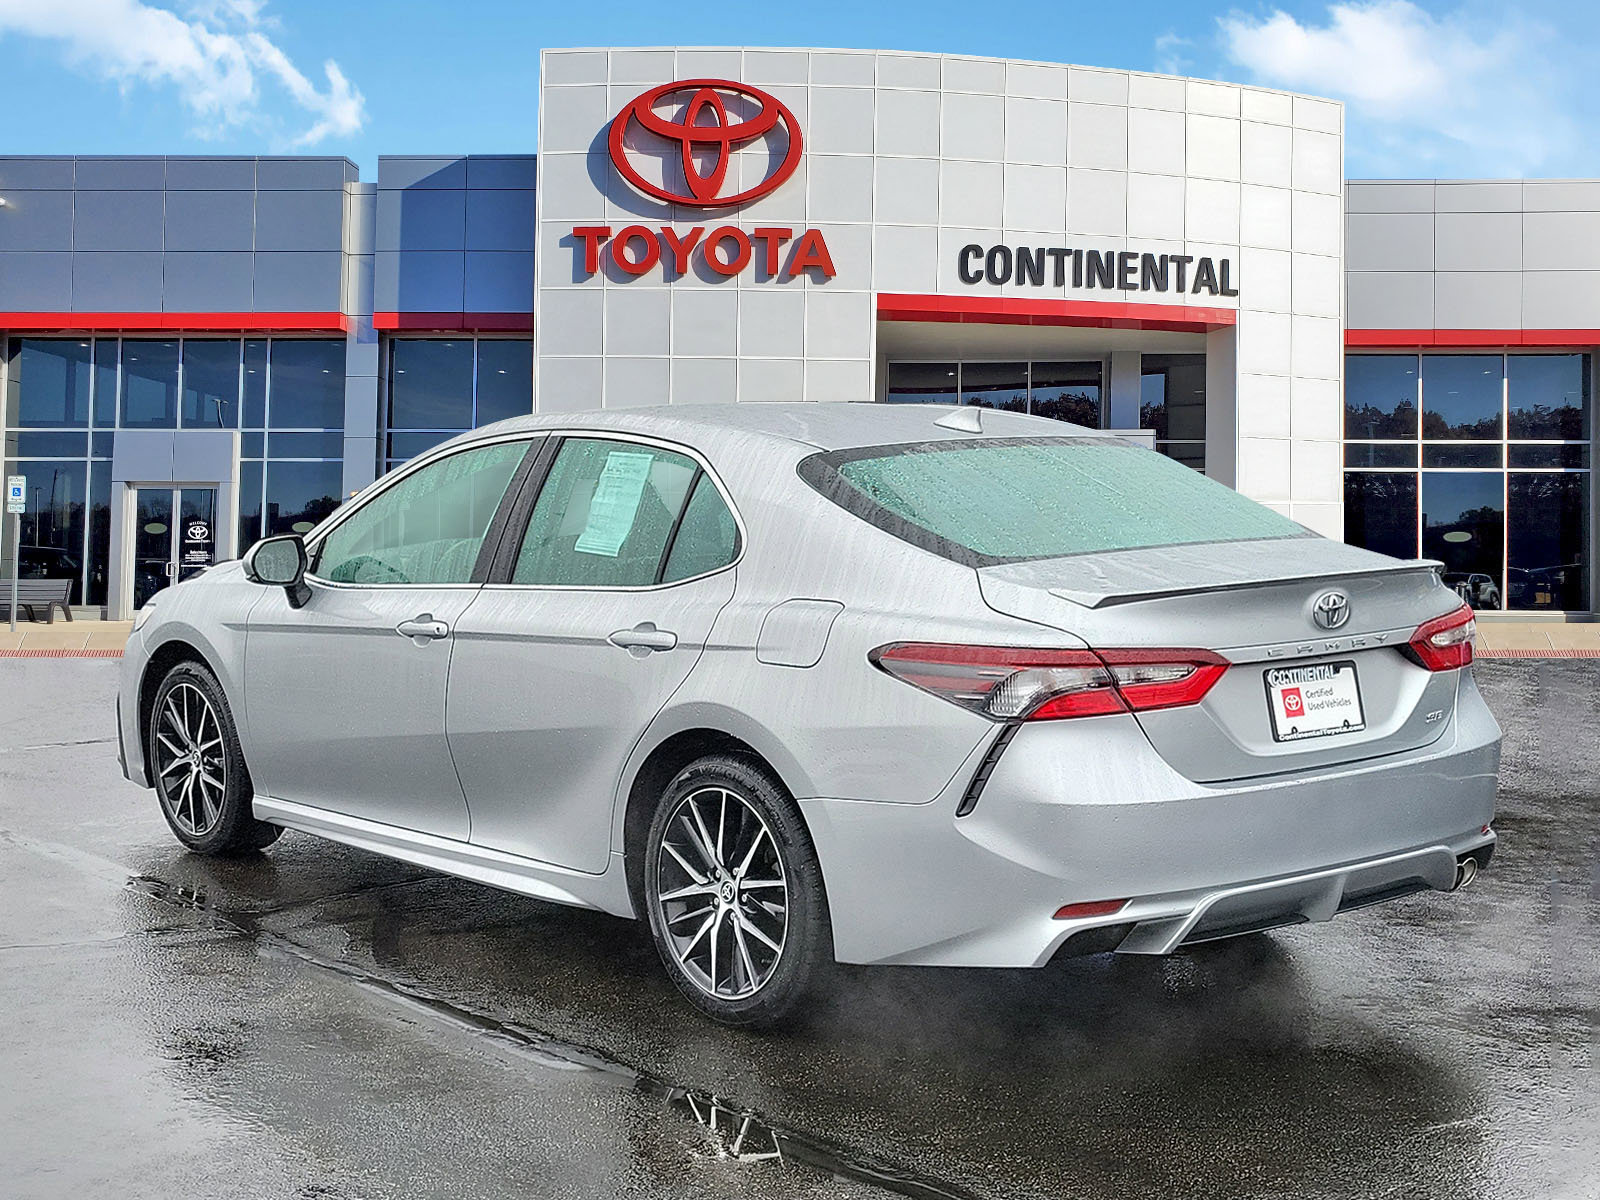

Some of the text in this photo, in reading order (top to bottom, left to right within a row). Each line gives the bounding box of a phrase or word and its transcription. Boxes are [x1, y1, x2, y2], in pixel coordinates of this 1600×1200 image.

[572, 225, 837, 276] TOYOTA
[958, 244, 1239, 296] CONTINENTAL
[1267, 634, 1388, 657] CAMRY
[1267, 664, 1335, 688] CONTINENTAL
[1305, 687, 1334, 699] Certified
[1308, 697, 1352, 711] Used Vehicles
